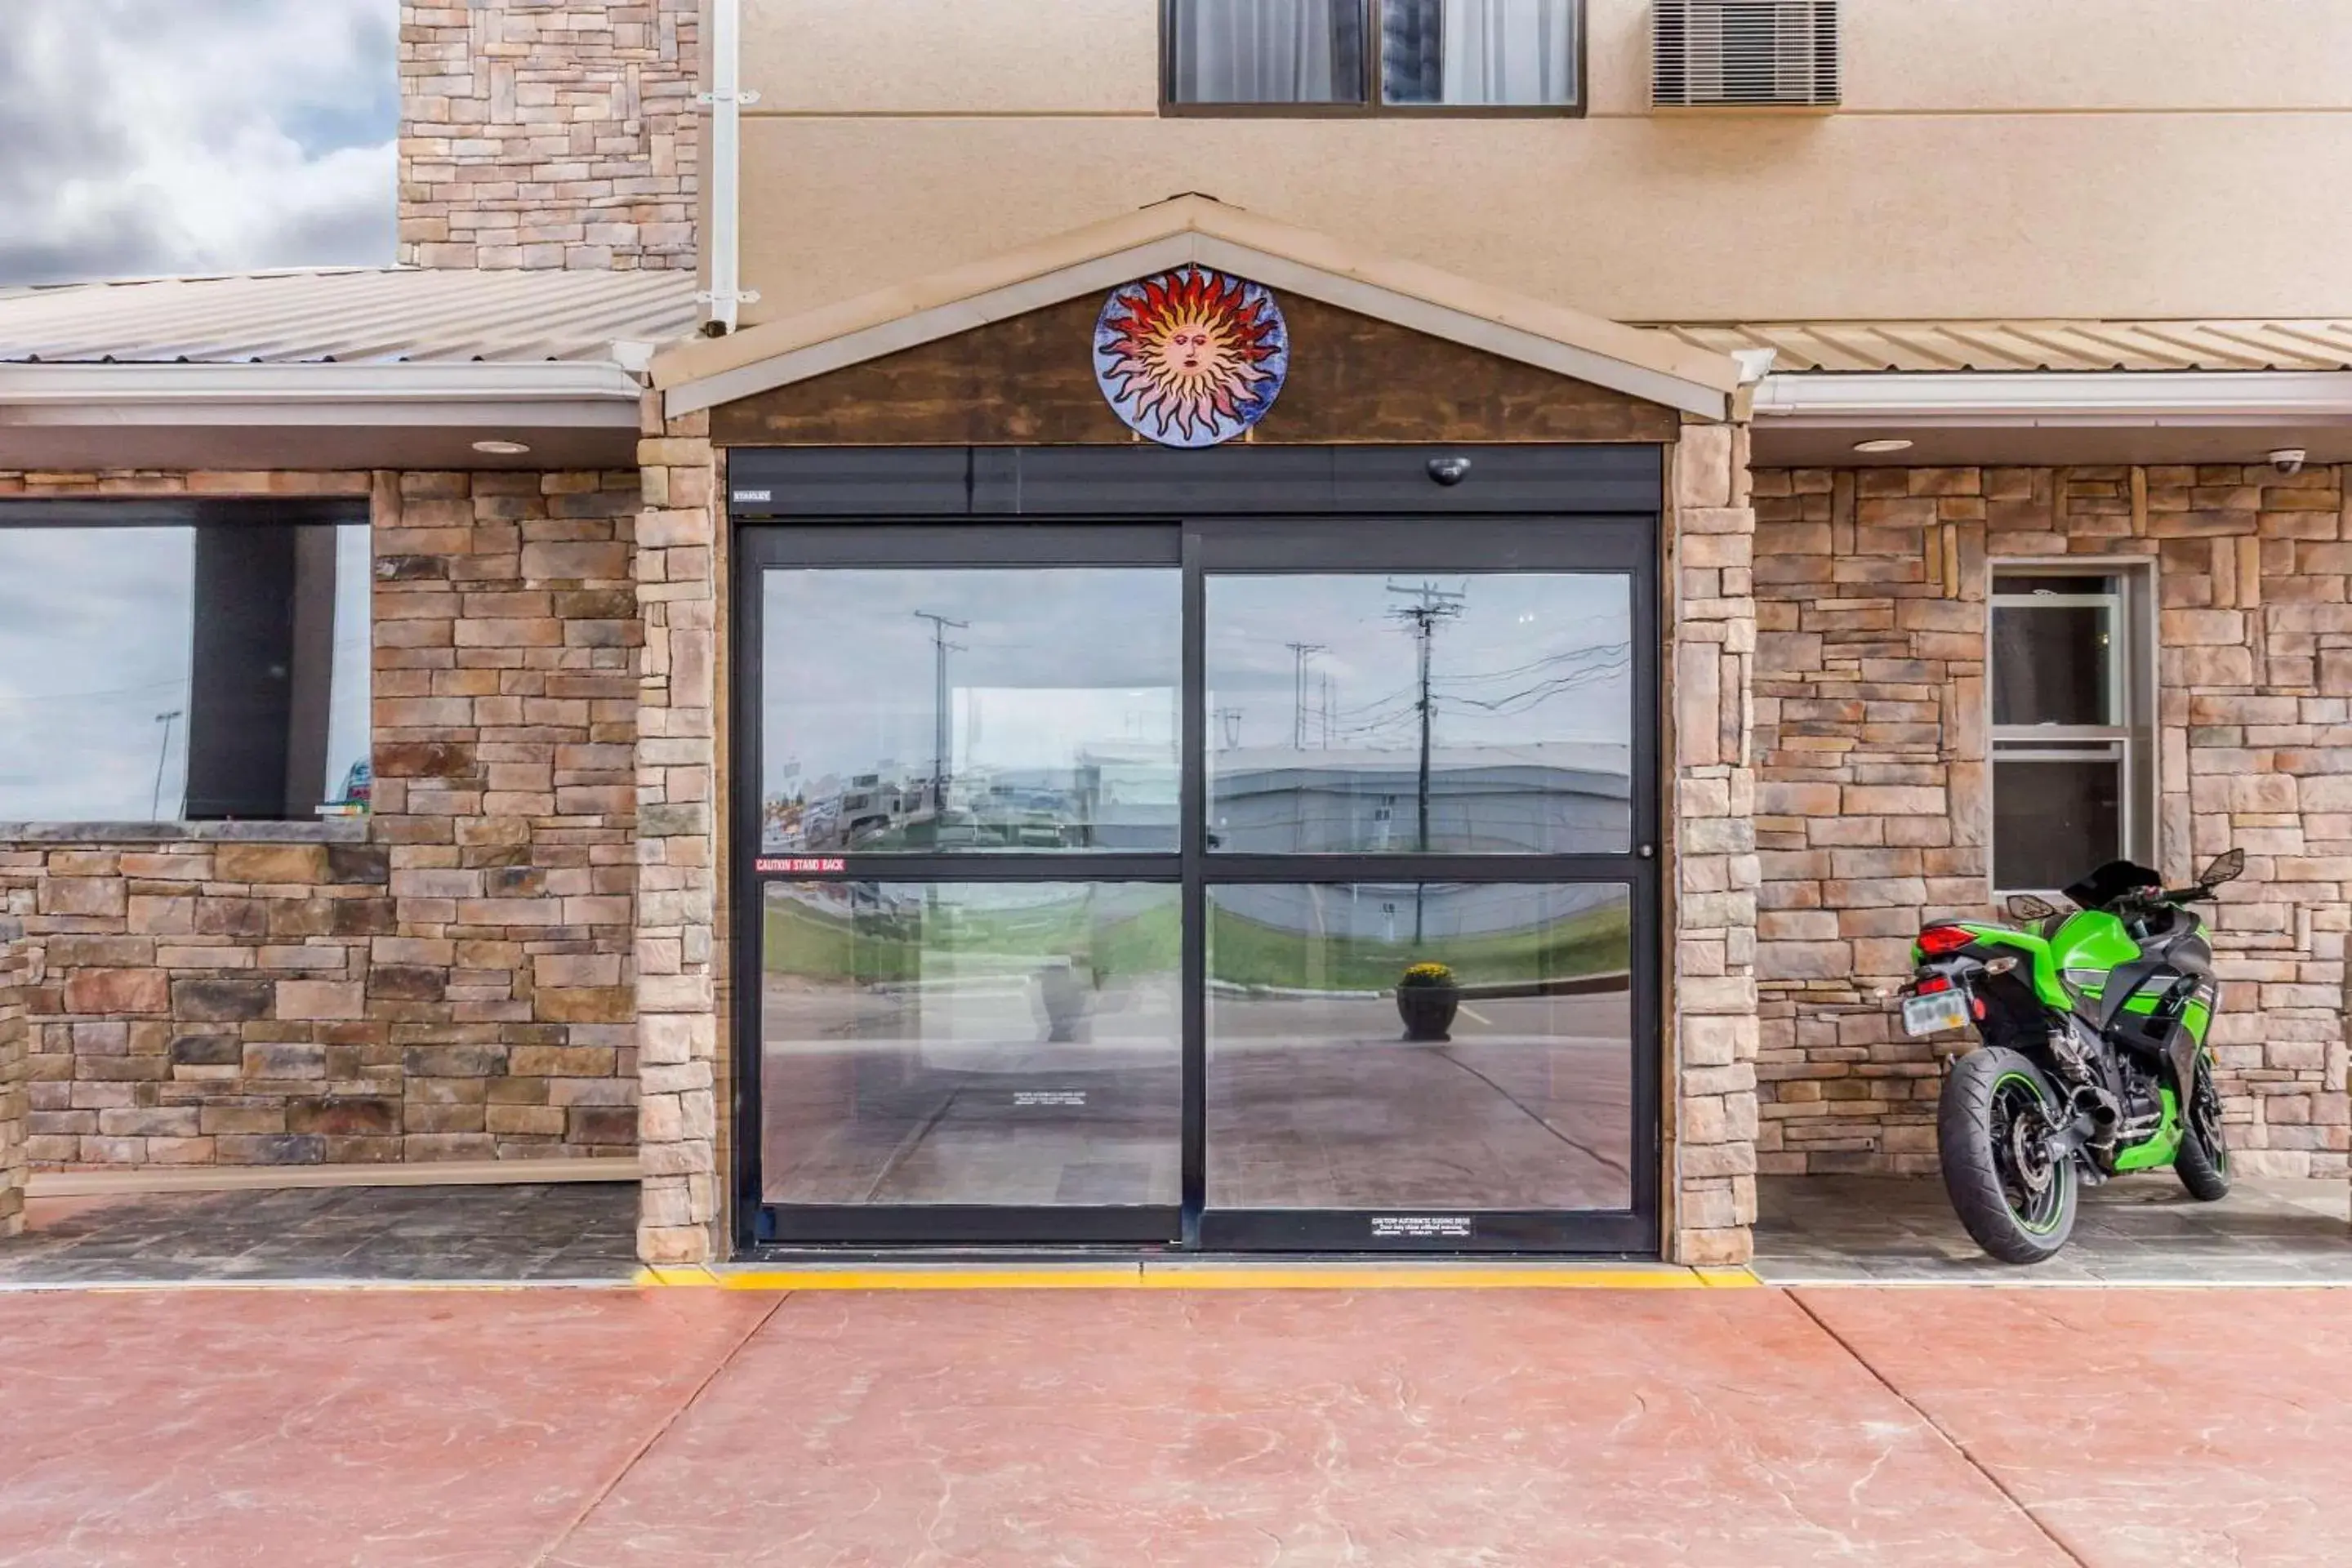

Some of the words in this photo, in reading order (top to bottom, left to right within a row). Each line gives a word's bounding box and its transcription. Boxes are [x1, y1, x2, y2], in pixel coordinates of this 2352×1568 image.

[756, 858, 791, 871] CAUTION
[793, 858, 819, 871] STAND
[822, 858, 844, 871] BACK
